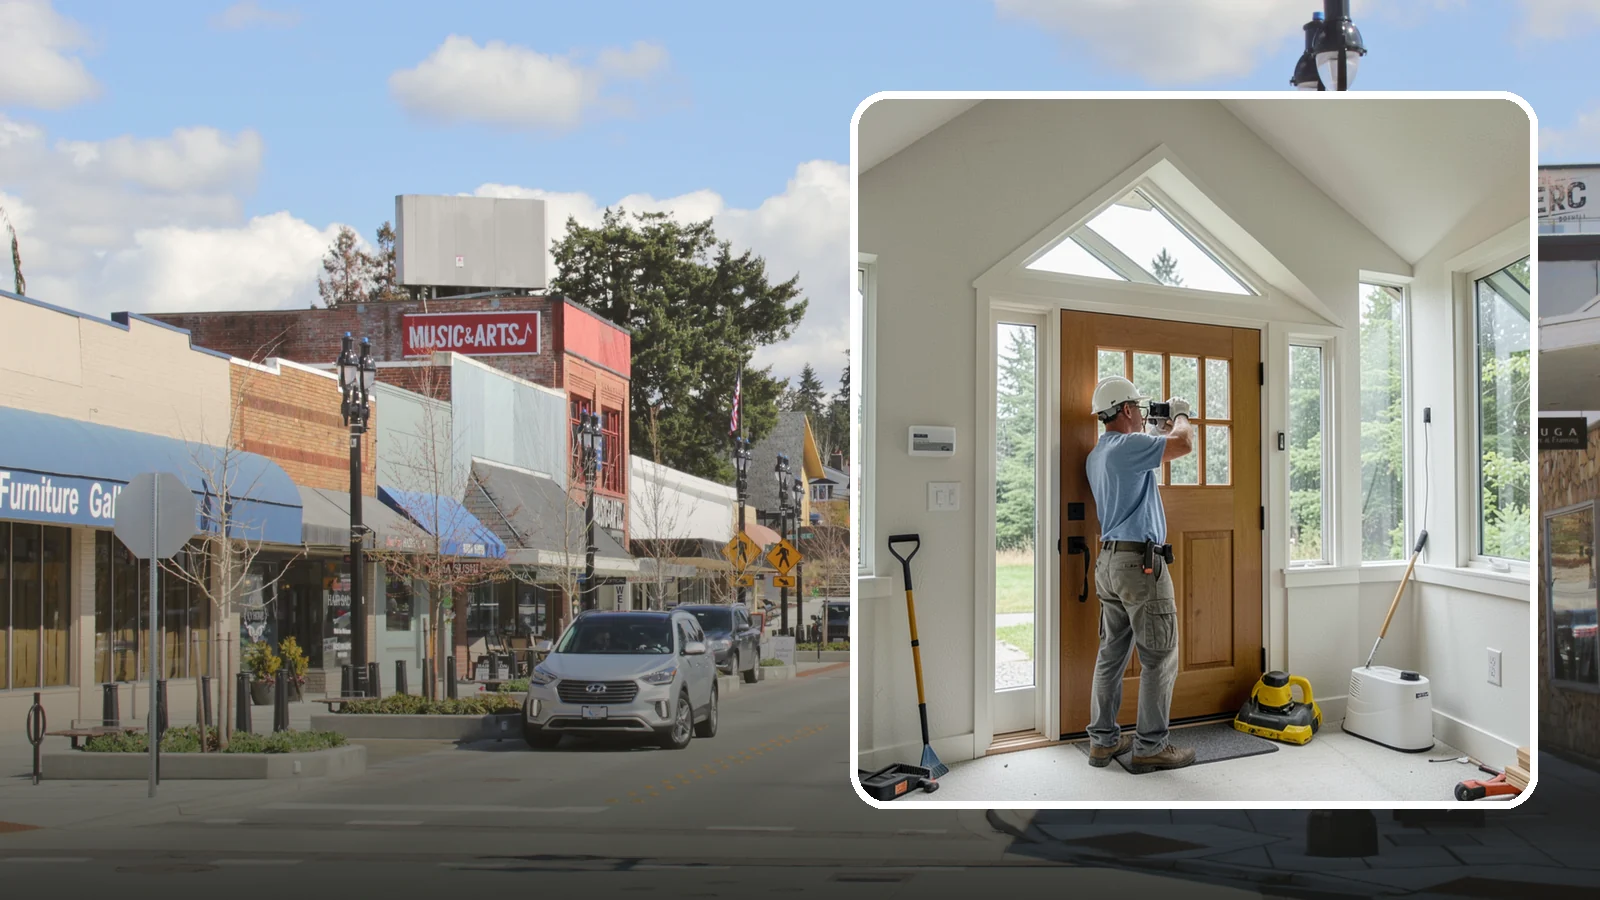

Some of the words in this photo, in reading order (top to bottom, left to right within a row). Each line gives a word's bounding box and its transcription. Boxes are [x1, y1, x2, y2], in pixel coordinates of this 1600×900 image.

[409, 323, 519, 348] MUSIC&ARTS
[0, 471, 79, 515] Furniture
[453, 563, 479, 574] SUSHI
